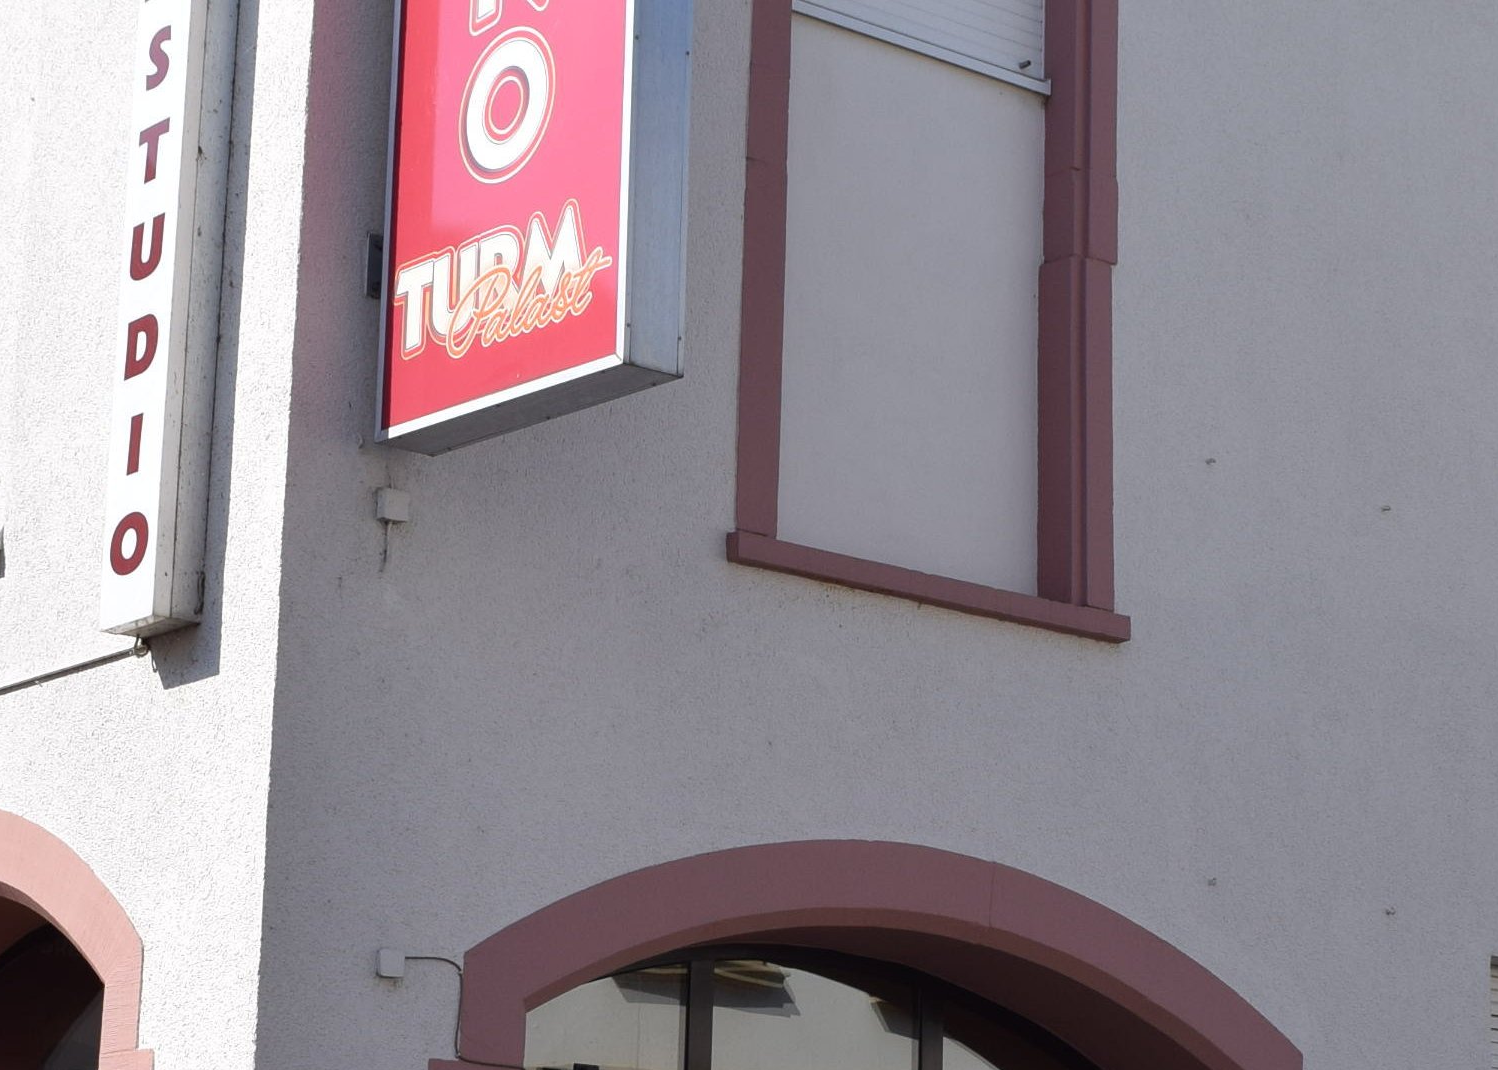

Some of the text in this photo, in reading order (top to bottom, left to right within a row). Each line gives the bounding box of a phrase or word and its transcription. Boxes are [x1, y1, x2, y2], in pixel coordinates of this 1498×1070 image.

[109, 25, 172, 576] STUDIO
[396, 202, 586, 357] TURM
[447, 247, 611, 359] Palast
